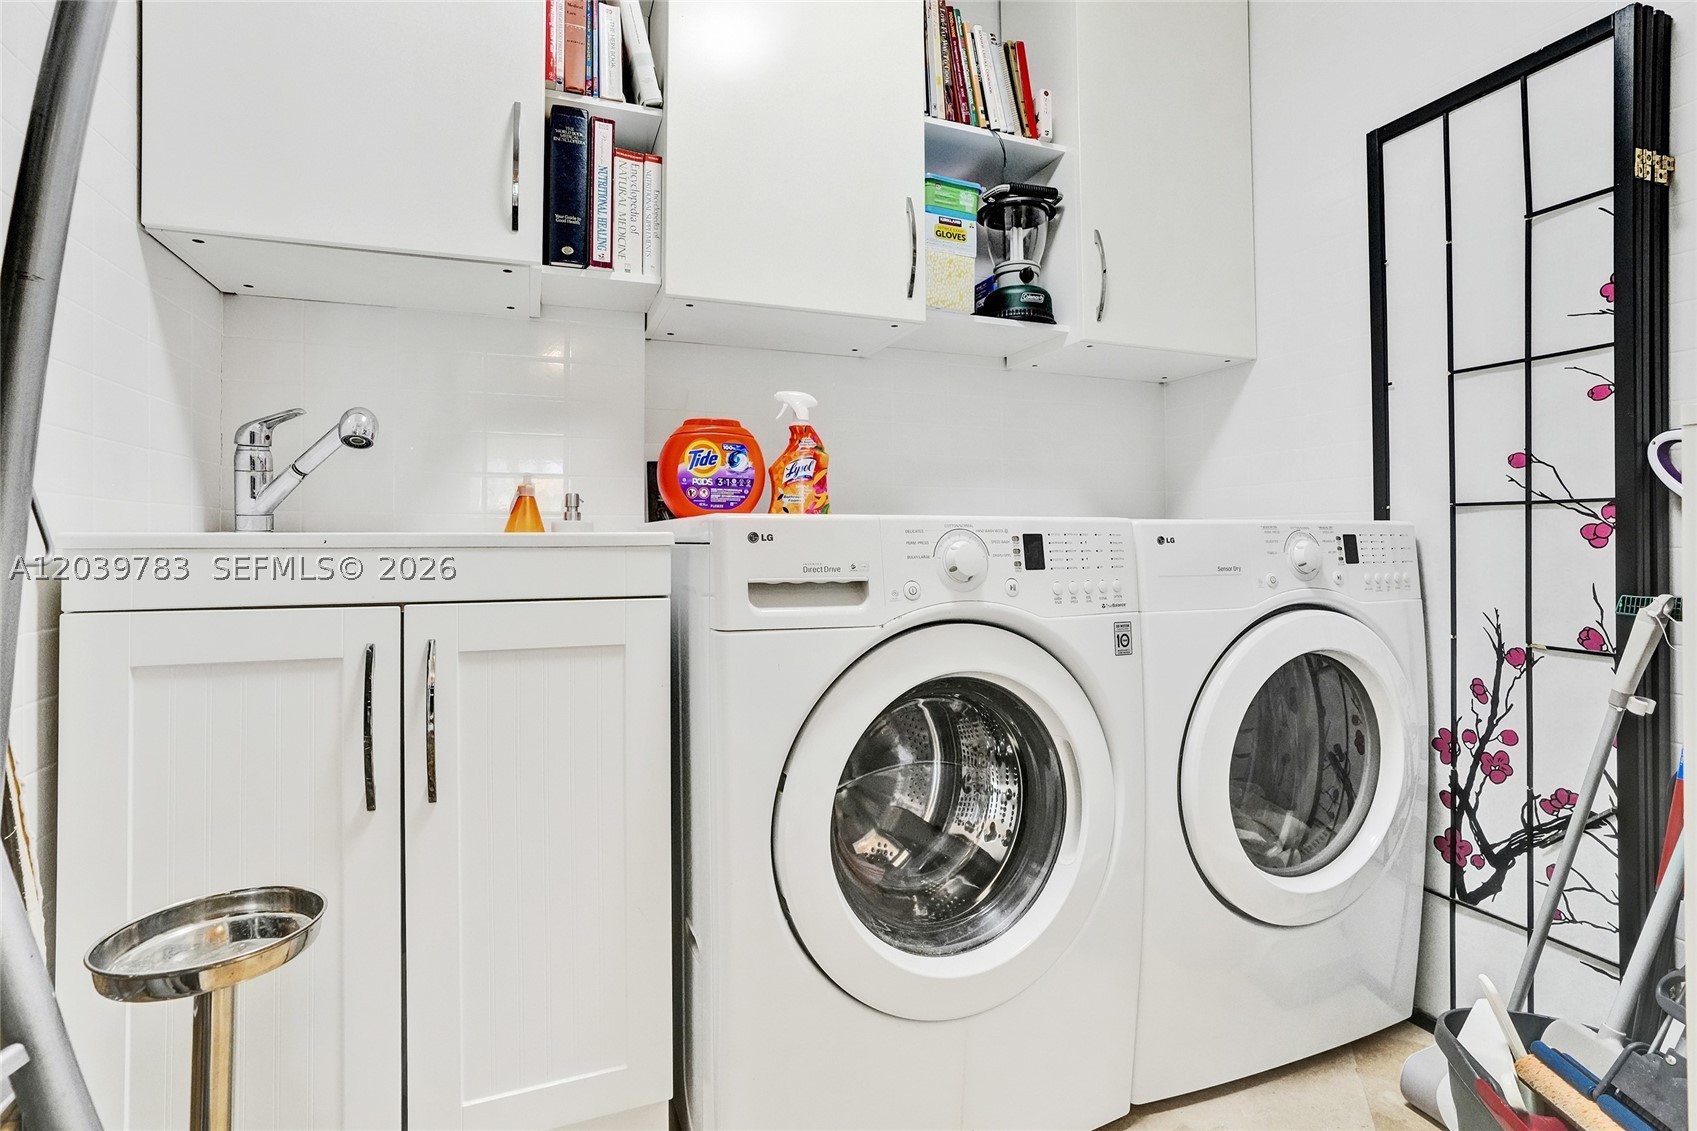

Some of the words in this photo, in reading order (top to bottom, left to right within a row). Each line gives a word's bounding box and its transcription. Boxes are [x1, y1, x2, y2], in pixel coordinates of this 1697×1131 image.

[598, 165, 608, 216] NUTRITIONAL
[618, 160, 628, 208] NATURAL
[628, 163, 640, 222] Encyclopedia
[596, 217, 608, 250] HEALING
[617, 212, 628, 260] MEDICINE
[630, 225, 640, 236] of
[936, 230, 966, 242] GLOVES
[688, 450, 718, 470] Tide
[786, 460, 814, 480] Lysol
[1117, 633, 1130, 648] 10
